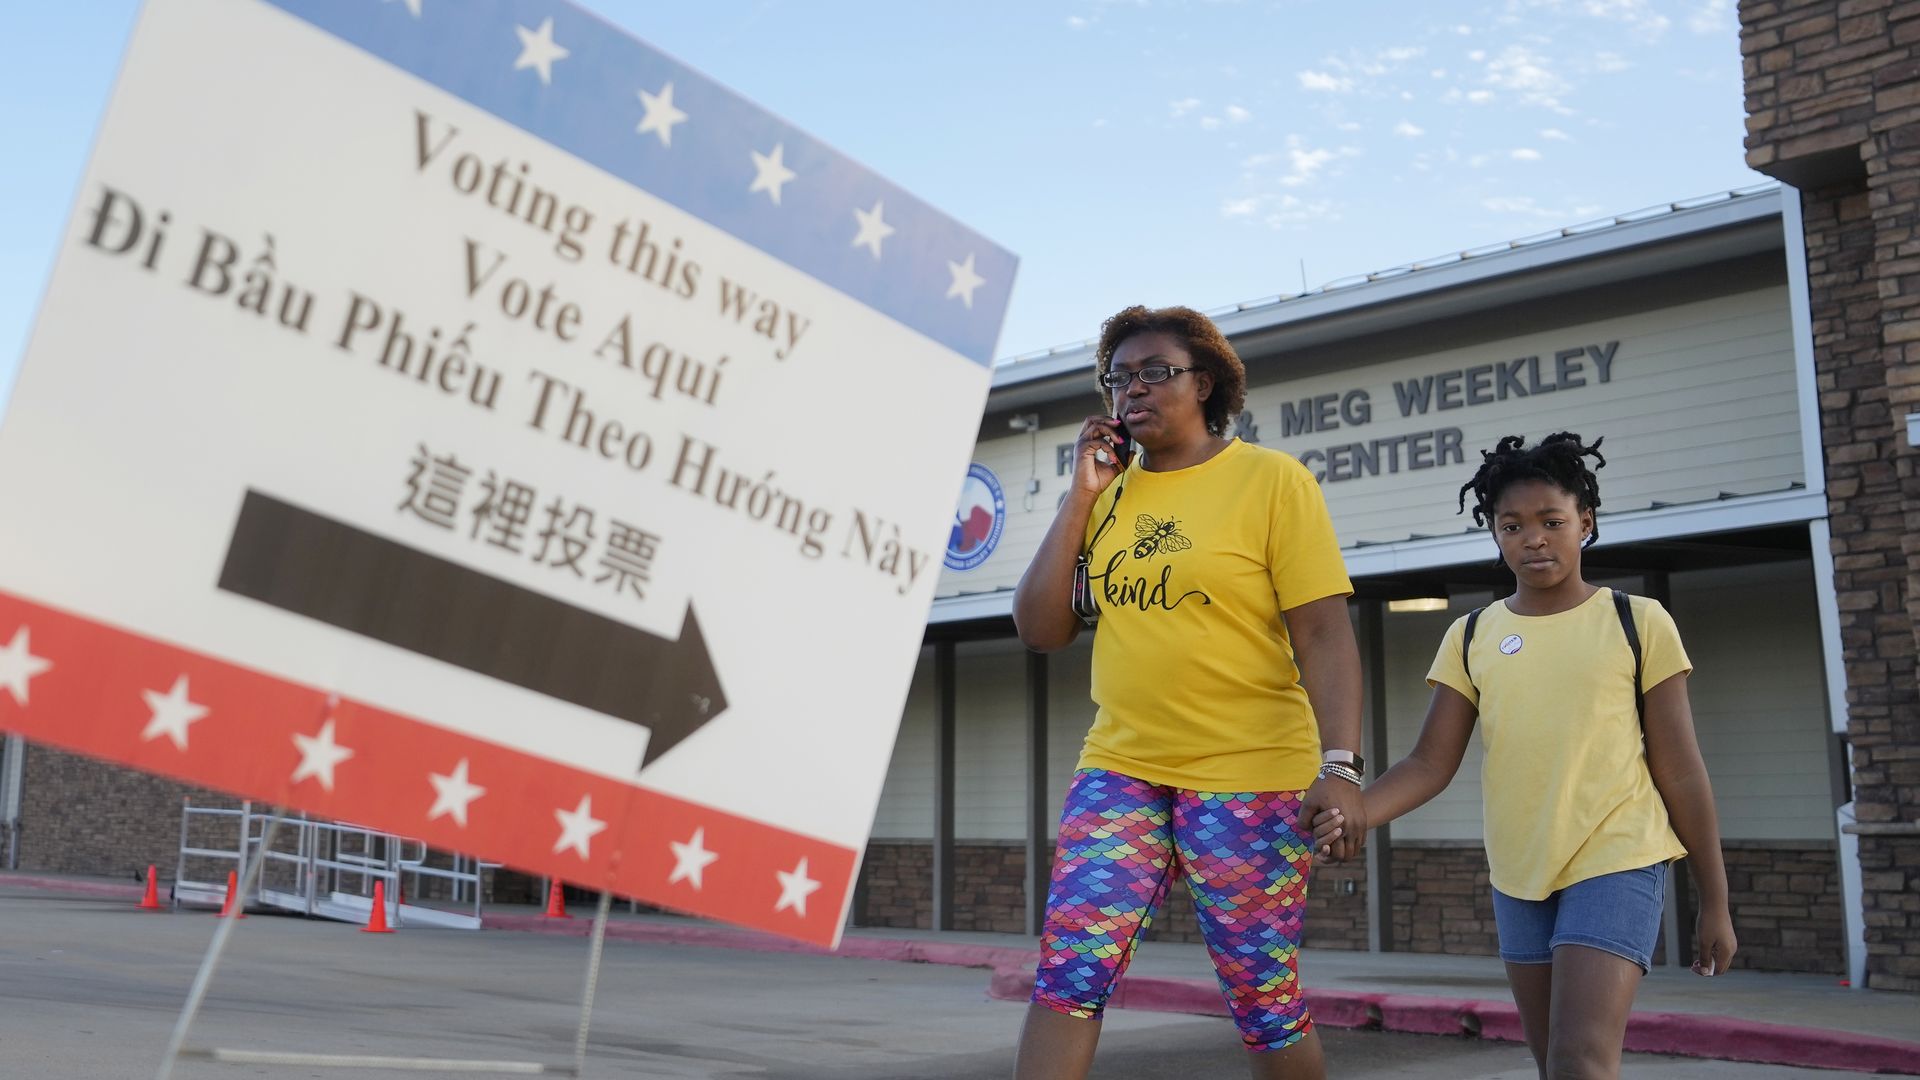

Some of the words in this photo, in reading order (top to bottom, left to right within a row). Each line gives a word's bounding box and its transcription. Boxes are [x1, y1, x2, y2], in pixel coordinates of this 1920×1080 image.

[413, 108, 597, 262] Voting
[608, 217, 702, 299] this
[717, 276, 812, 360] way
[85, 183, 173, 272] Đi
[184, 226, 316, 334] Bầu
[333, 291, 504, 411] Phiếu
[526, 369, 654, 471] Theo
[668, 432, 833, 560] Hướng
[842, 507, 930, 595] Này
[463, 237, 583, 342] Vote
[594, 313, 730, 406] Aquí
[1281, 389, 1371, 438] MEG
[1392, 340, 1620, 418] WEEKLEY
[398, 443, 662, 601] 這裡投票
[1299, 426, 1464, 484] CENTER
[1089, 550, 1211, 611] kind
